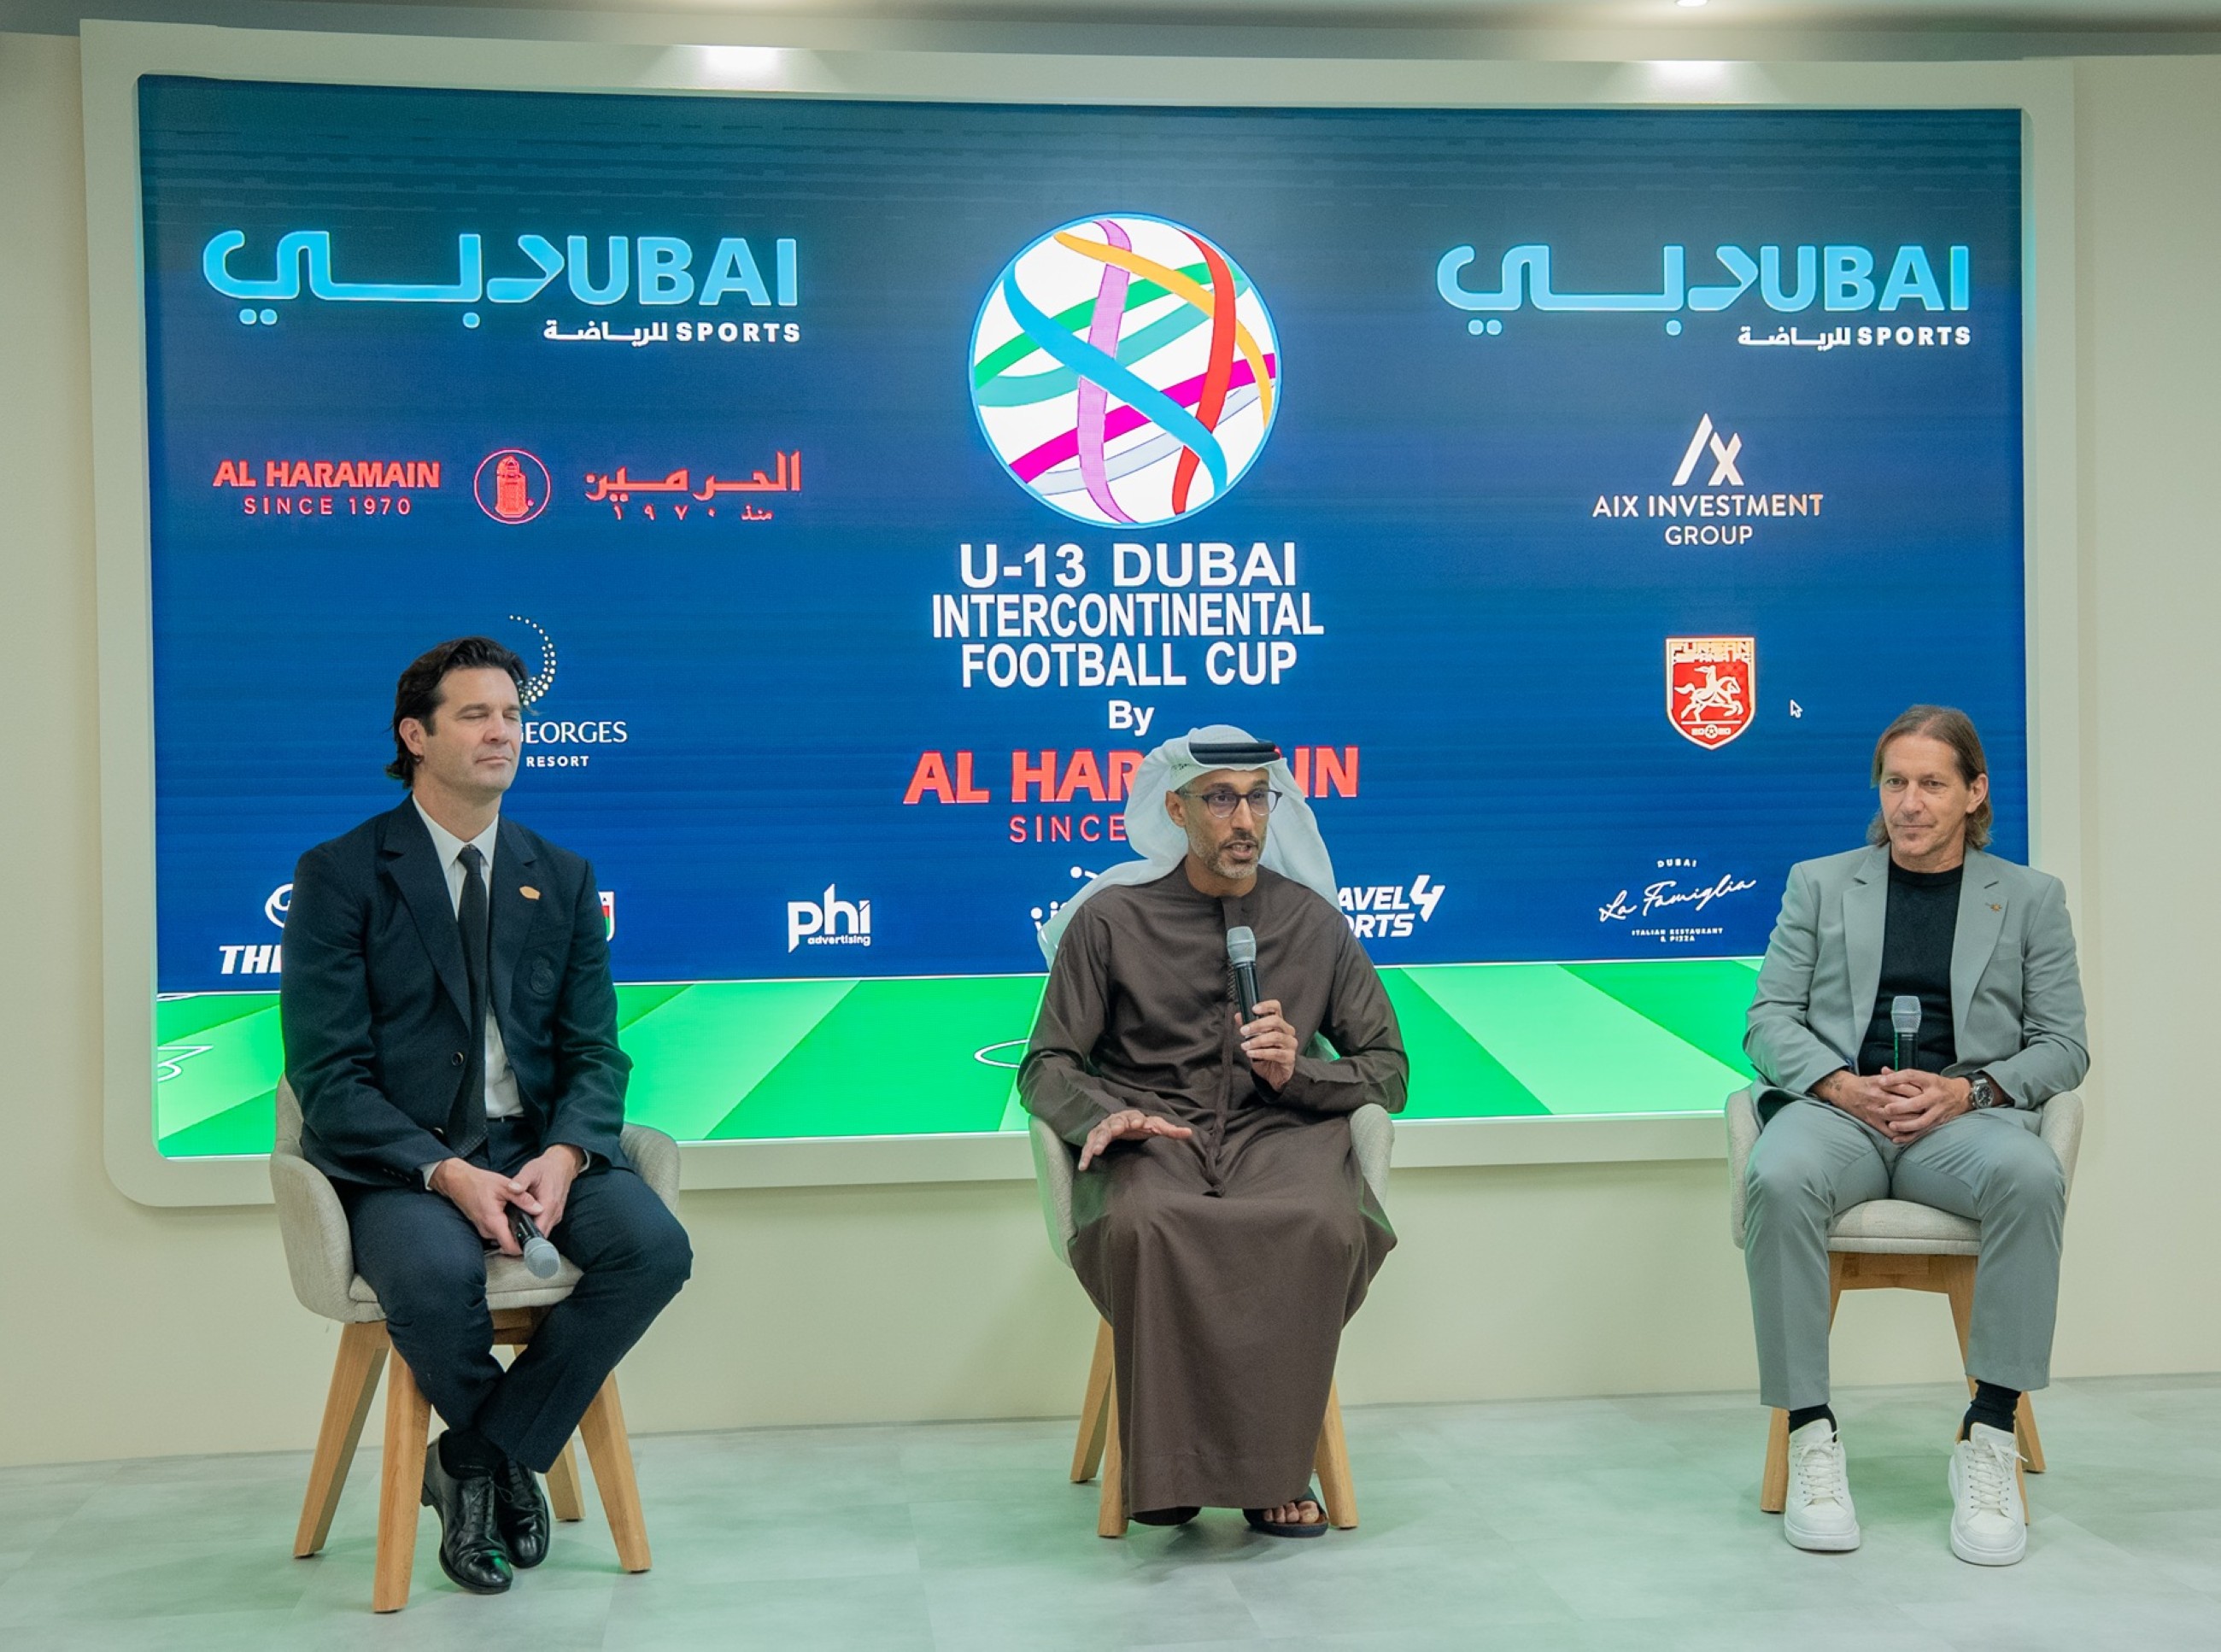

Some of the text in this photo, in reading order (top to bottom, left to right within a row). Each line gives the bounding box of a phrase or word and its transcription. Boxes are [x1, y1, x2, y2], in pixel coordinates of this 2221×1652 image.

[542, 318, 669, 350] للرياضة
[675, 320, 801, 343] SPORTS
[1736, 324, 1852, 353] للرياضة
[1857, 325, 1972, 347] SPORTS
[213, 460, 441, 489] AL HARAMAIN
[584, 449, 801, 502] الحرمين
[243, 496, 412, 516] SINCE 1970
[740, 504, 773, 521] منذ
[1591, 493, 1824, 518] AIX INVESTMENT
[1664, 524, 1754, 546] GROUP
[959, 541, 1297, 589] U-13 DUBAI
[931, 591, 1325, 639] INTERCONTINENTAL
[961, 641, 1298, 688] FOOTBALL CUP
[1107, 699, 1155, 736] By
[520, 721, 628, 744] EORGES
[525, 755, 590, 767] RESORT
[902, 745, 1360, 805] AL HARIN
[1009, 814, 1126, 844] SINCE
[1656, 858, 1698, 868] DUBAI
[1337, 886, 1410, 911] AVEL
[1598, 873, 1757, 923] La Famiglia
[787, 882, 870, 954] phi
[1345, 912, 1415, 939] RTS
[807, 934, 871, 946] advertising
